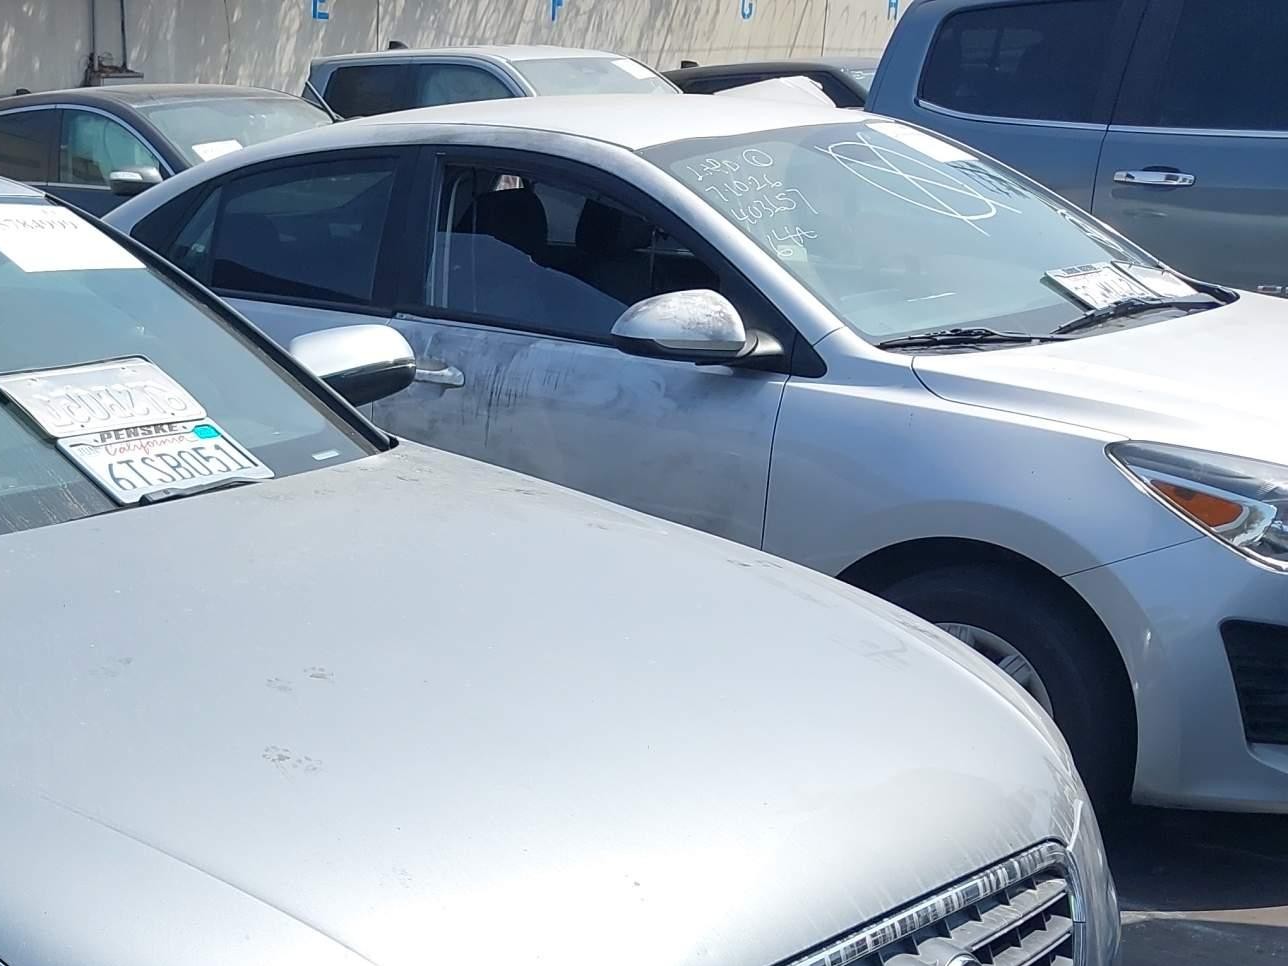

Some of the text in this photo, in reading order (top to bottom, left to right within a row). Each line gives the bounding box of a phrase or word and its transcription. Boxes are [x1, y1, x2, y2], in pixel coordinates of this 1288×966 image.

[99, 424, 179, 443] PENSKE
[104, 436, 188, 456] California
[108, 443, 254, 491] 6TSB051
